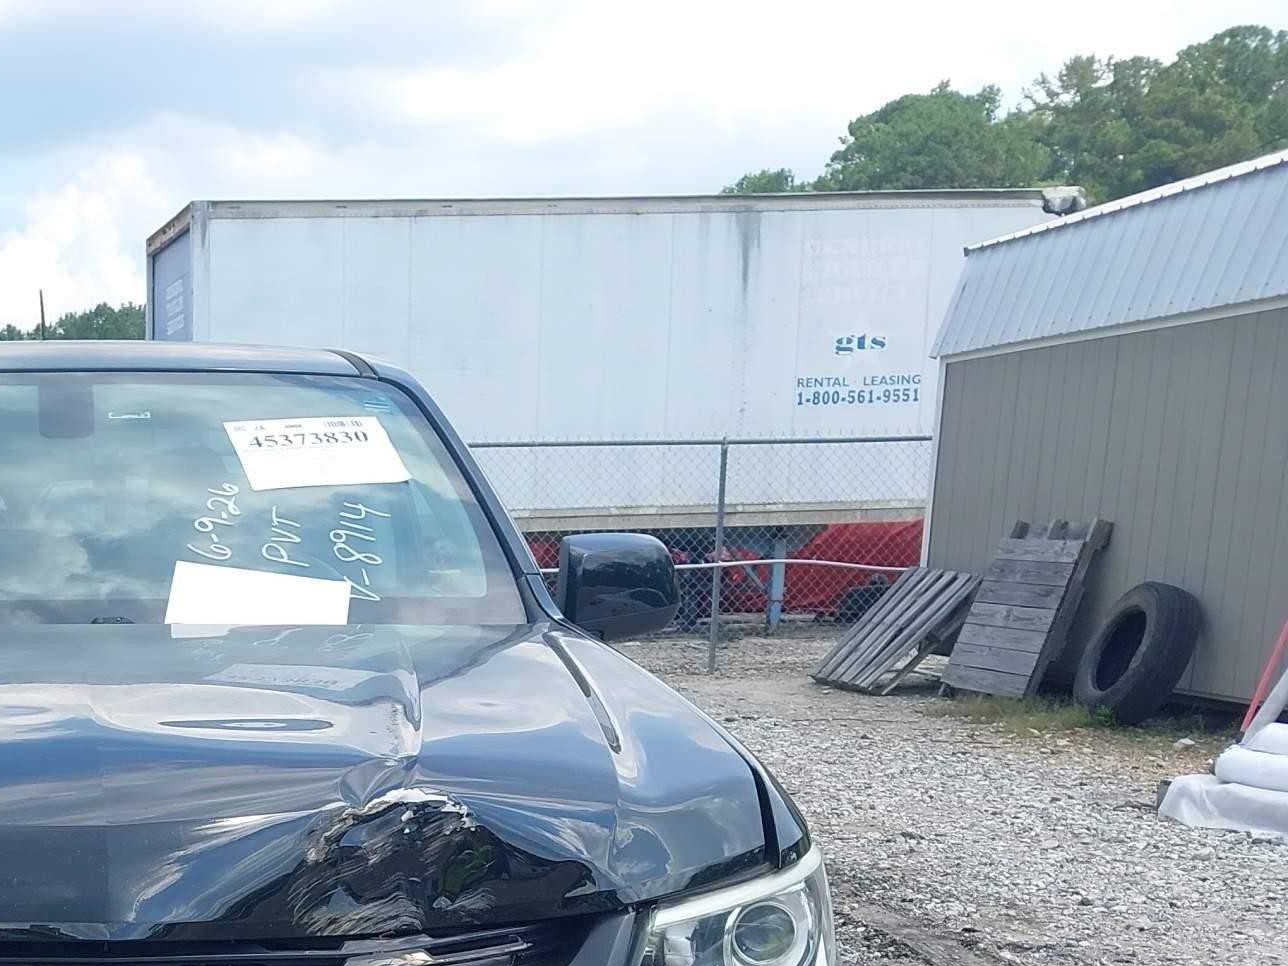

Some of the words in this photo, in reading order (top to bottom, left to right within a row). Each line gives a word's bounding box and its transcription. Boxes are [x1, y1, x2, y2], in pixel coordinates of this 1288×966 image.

[835, 333, 886, 355] gts
[797, 377, 849, 388] RENTAL
[863, 374, 921, 386] LEASING
[797, 388, 920, 406] 1-800-561-9551
[249, 430, 369, 448] 45373830
